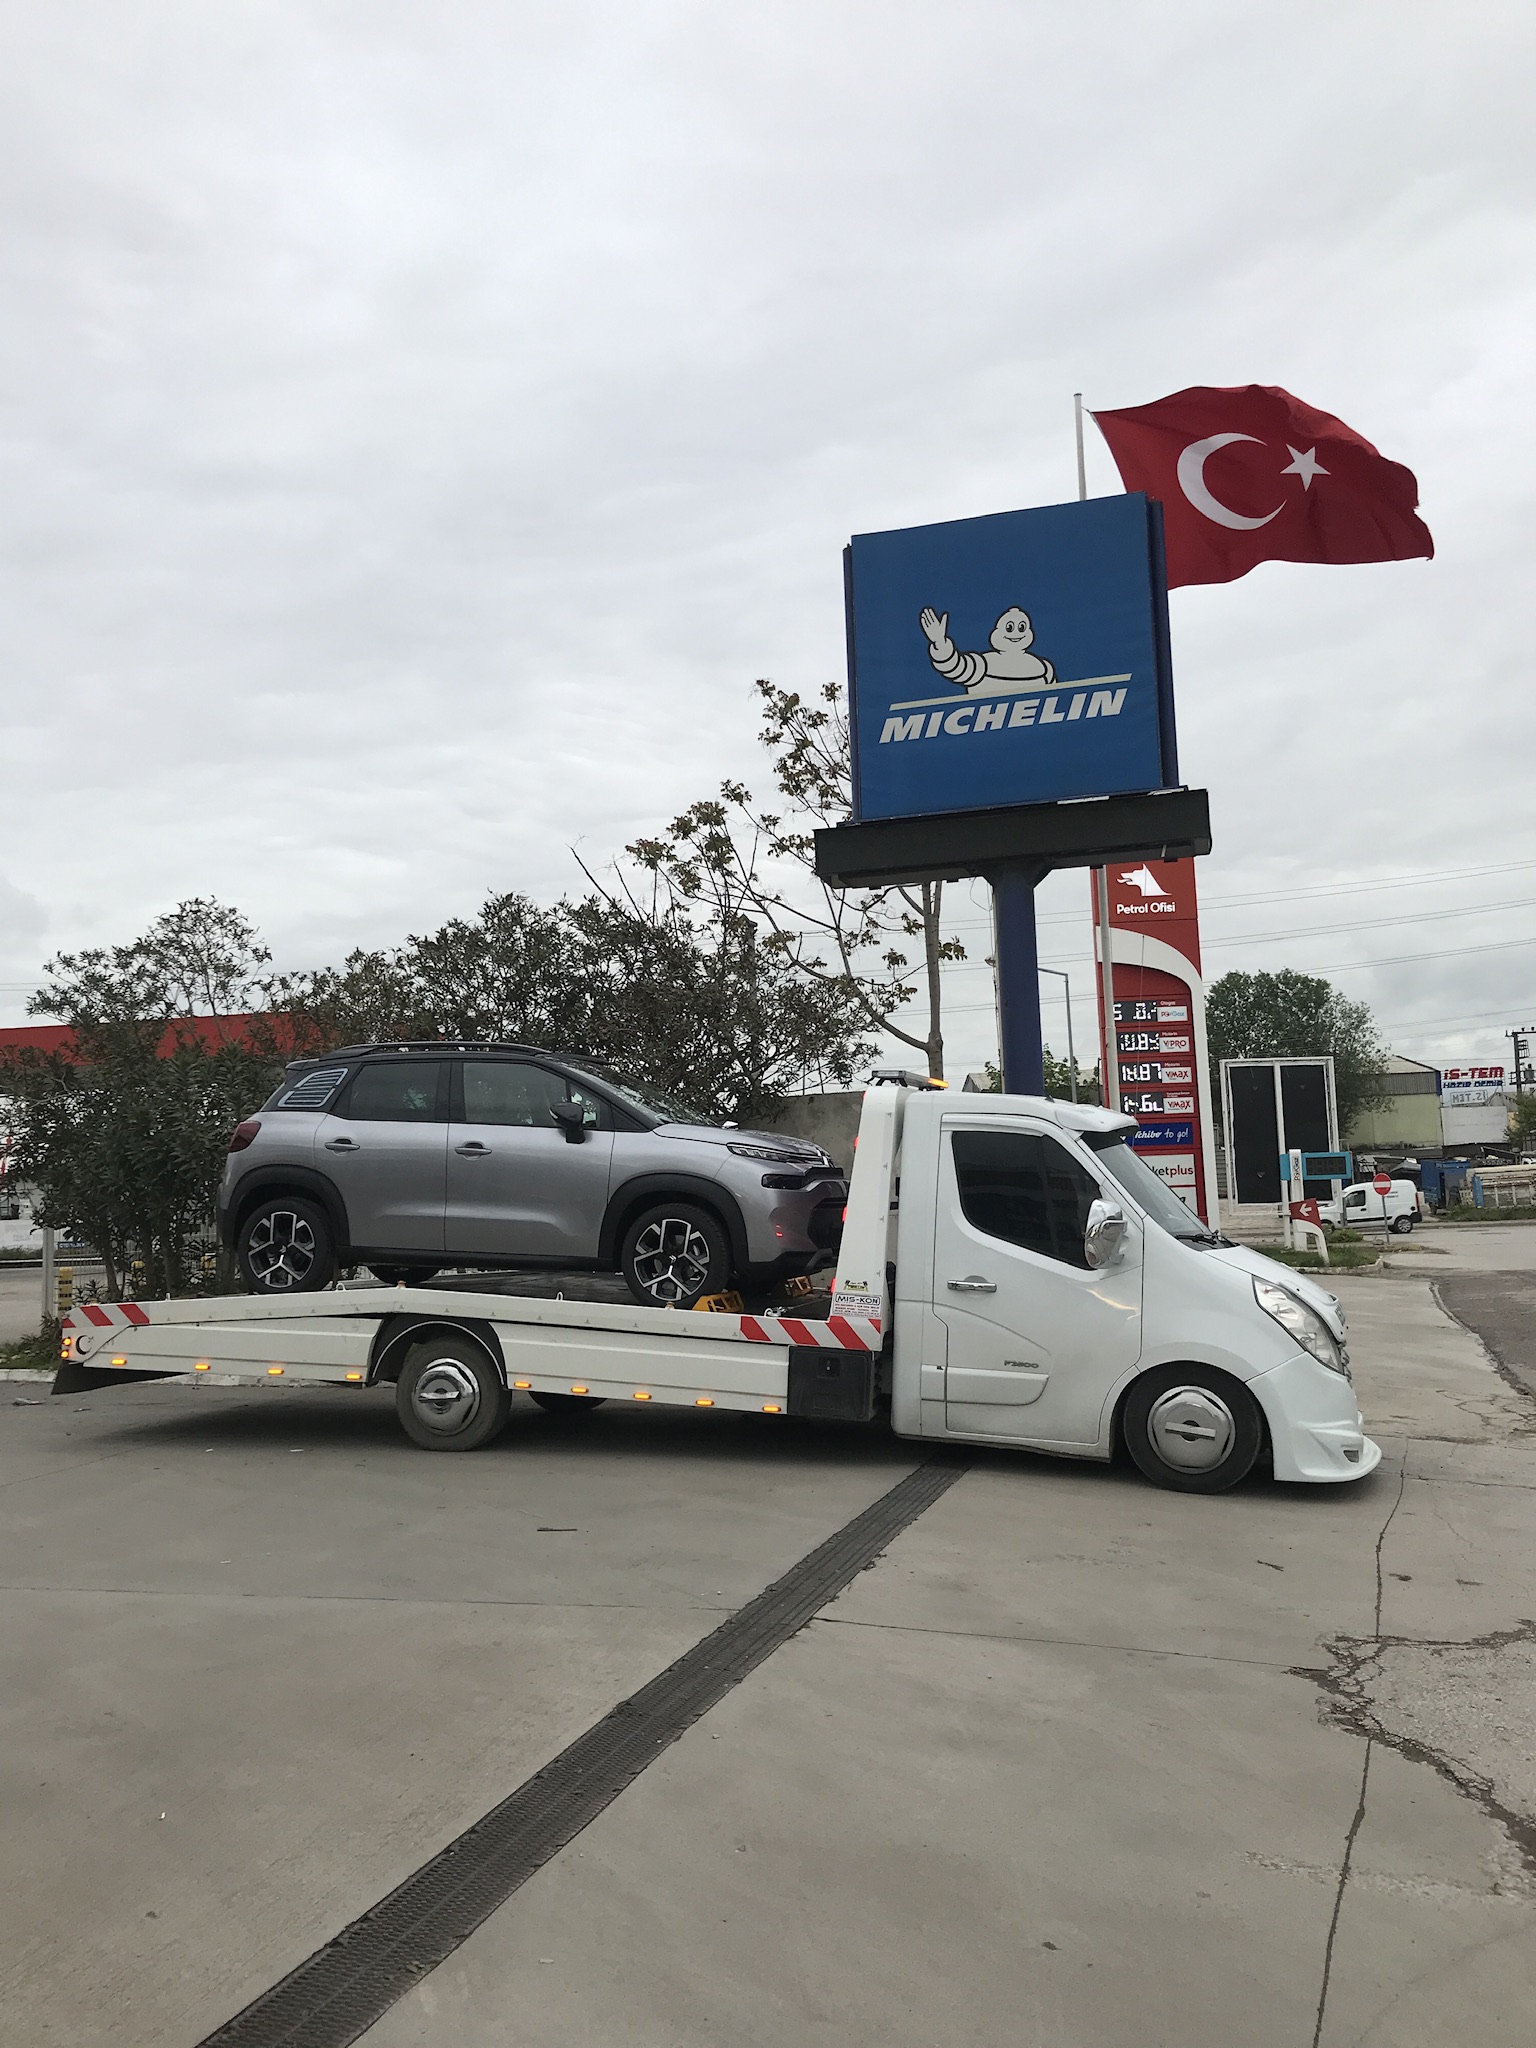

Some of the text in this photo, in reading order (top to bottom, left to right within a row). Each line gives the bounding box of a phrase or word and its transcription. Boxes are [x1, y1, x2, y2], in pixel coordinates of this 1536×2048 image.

[879, 688, 1128, 743] MICHELIN
[1116, 901, 1176, 915] Petrol Ofisi
[1164, 1128, 1175, 1139] to
[1176, 1127, 1189, 1143] go!
[1152, 1164, 1194, 1179] ketplus
